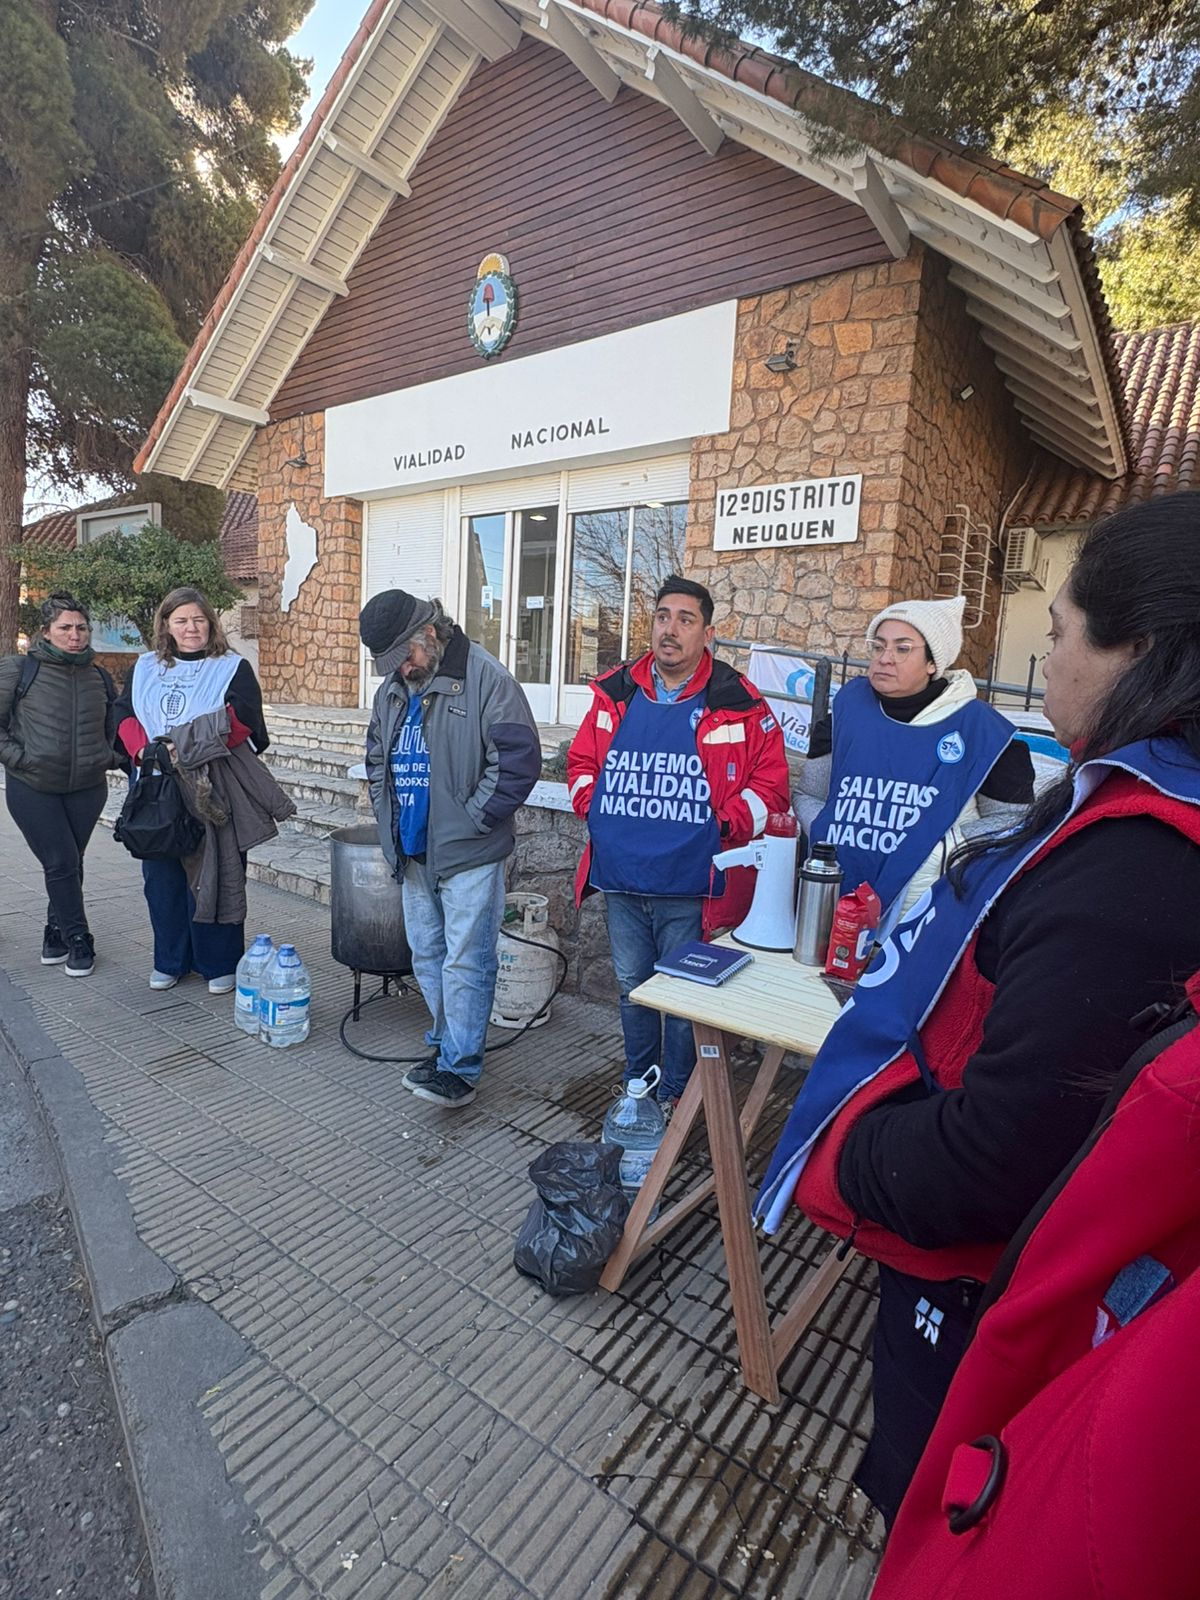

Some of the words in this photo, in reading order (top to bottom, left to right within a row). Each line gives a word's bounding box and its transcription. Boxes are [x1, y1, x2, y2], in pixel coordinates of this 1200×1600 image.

[393, 444, 466, 471] VIALIDAD
[511, 417, 610, 450] NACIONAL
[732, 519, 835, 545] NEUQUEN
[605, 749, 706, 778] SALVEMO
[605, 771, 711, 802] VIALIDAD
